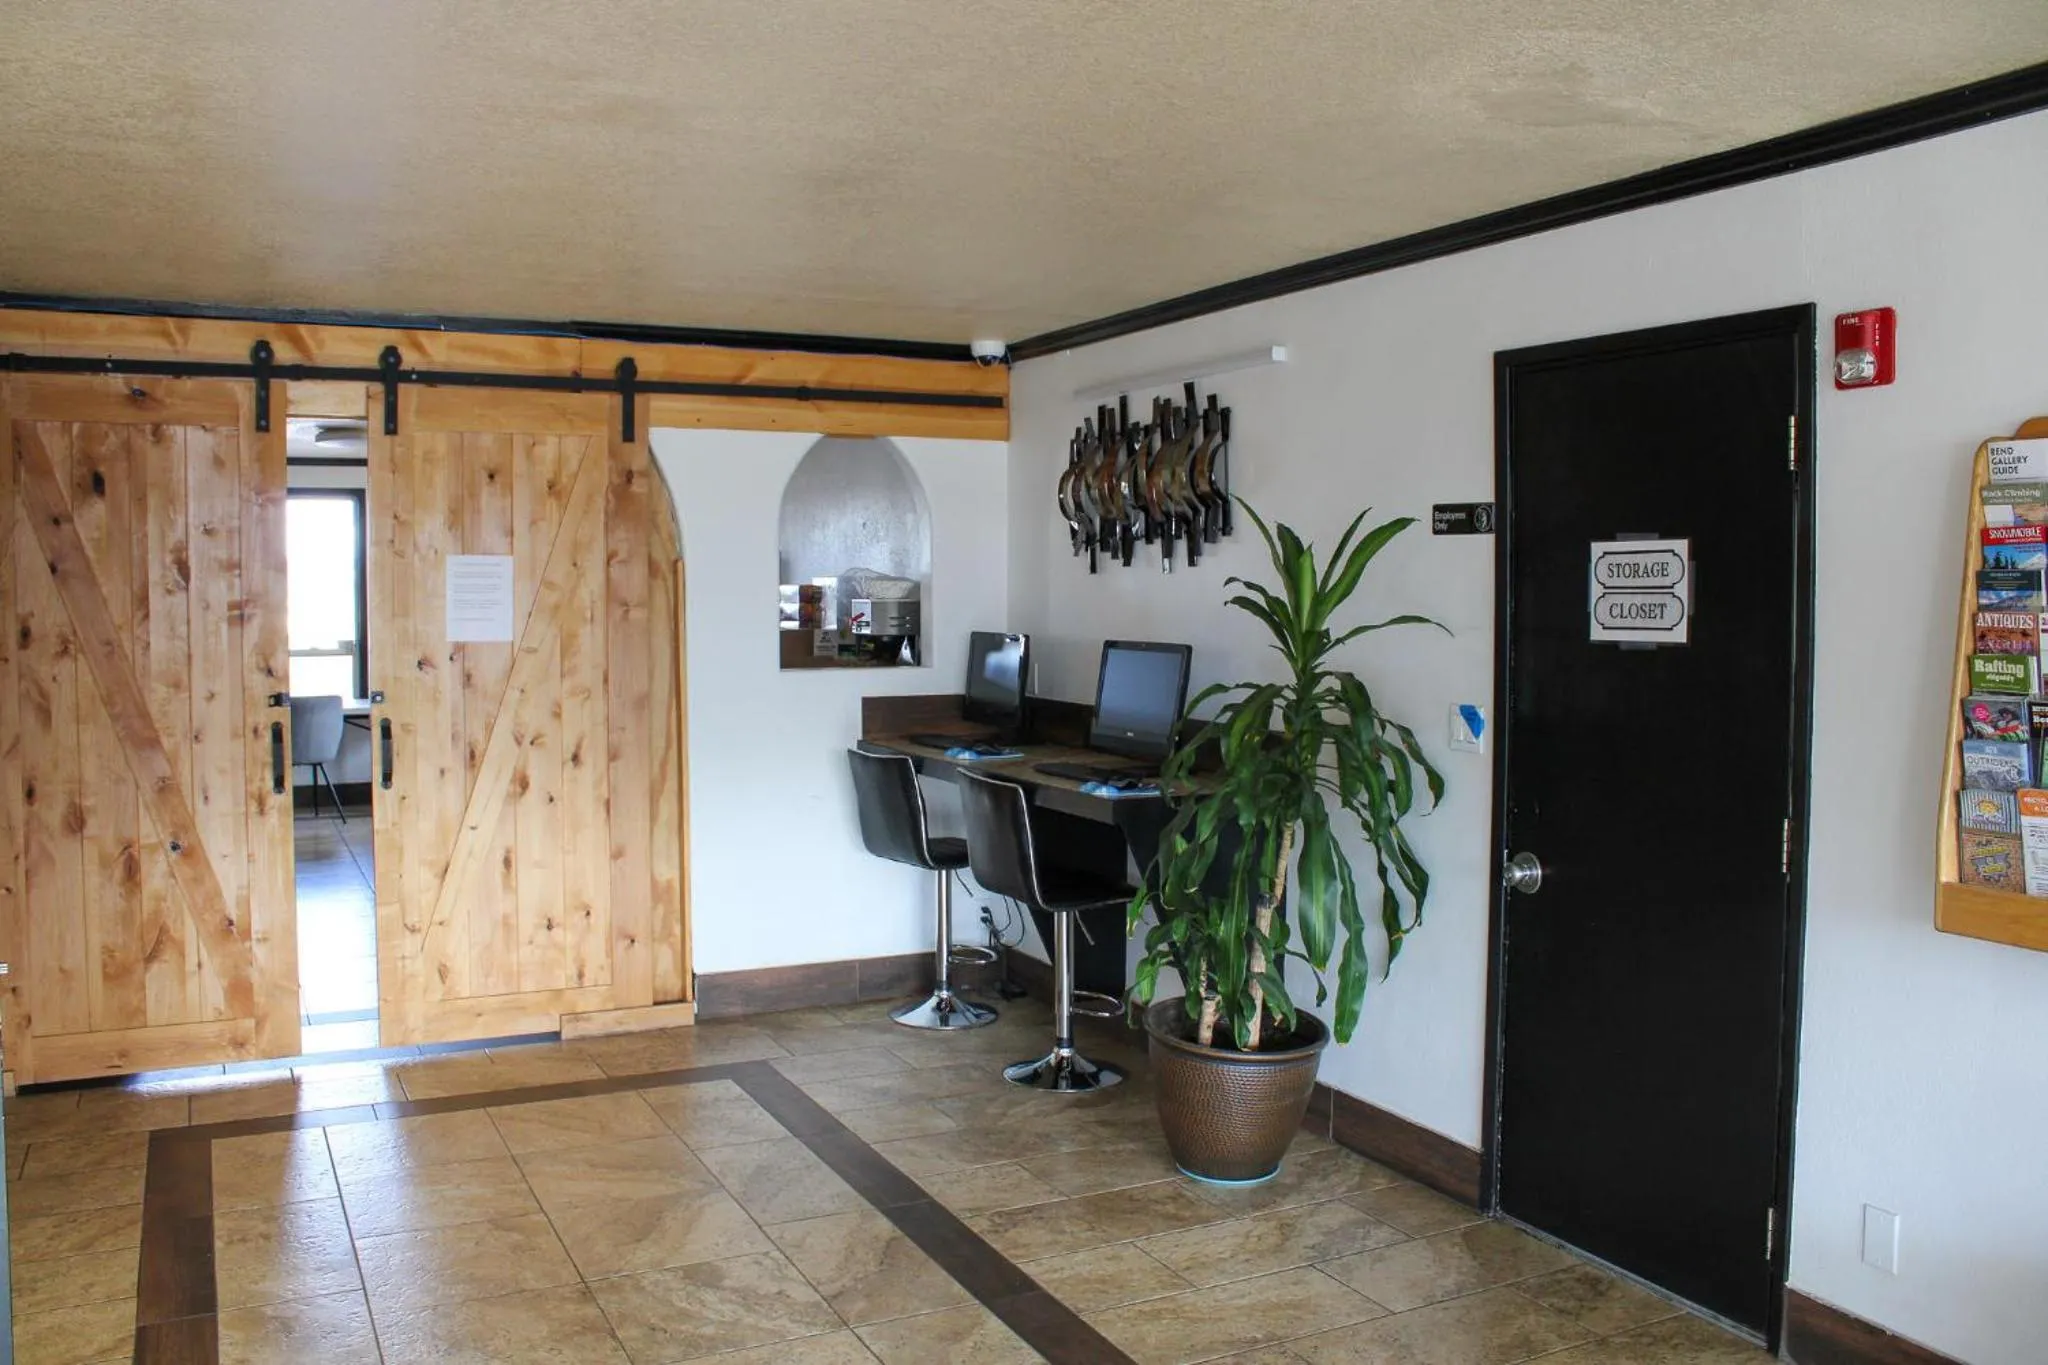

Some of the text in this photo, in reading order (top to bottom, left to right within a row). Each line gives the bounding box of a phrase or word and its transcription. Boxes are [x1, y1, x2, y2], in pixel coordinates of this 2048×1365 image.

[1991, 455, 2029, 466] GALLERY
[1991, 465, 2019, 475] GUIDE
[1988, 526, 2042, 539] SNOWMOBILE
[1607, 561, 1669, 579] STORAGE
[1609, 602, 1668, 620] CLOSET
[1976, 612, 2034, 629] ANTIQUES
[1974, 658, 2025, 678] Rafting
